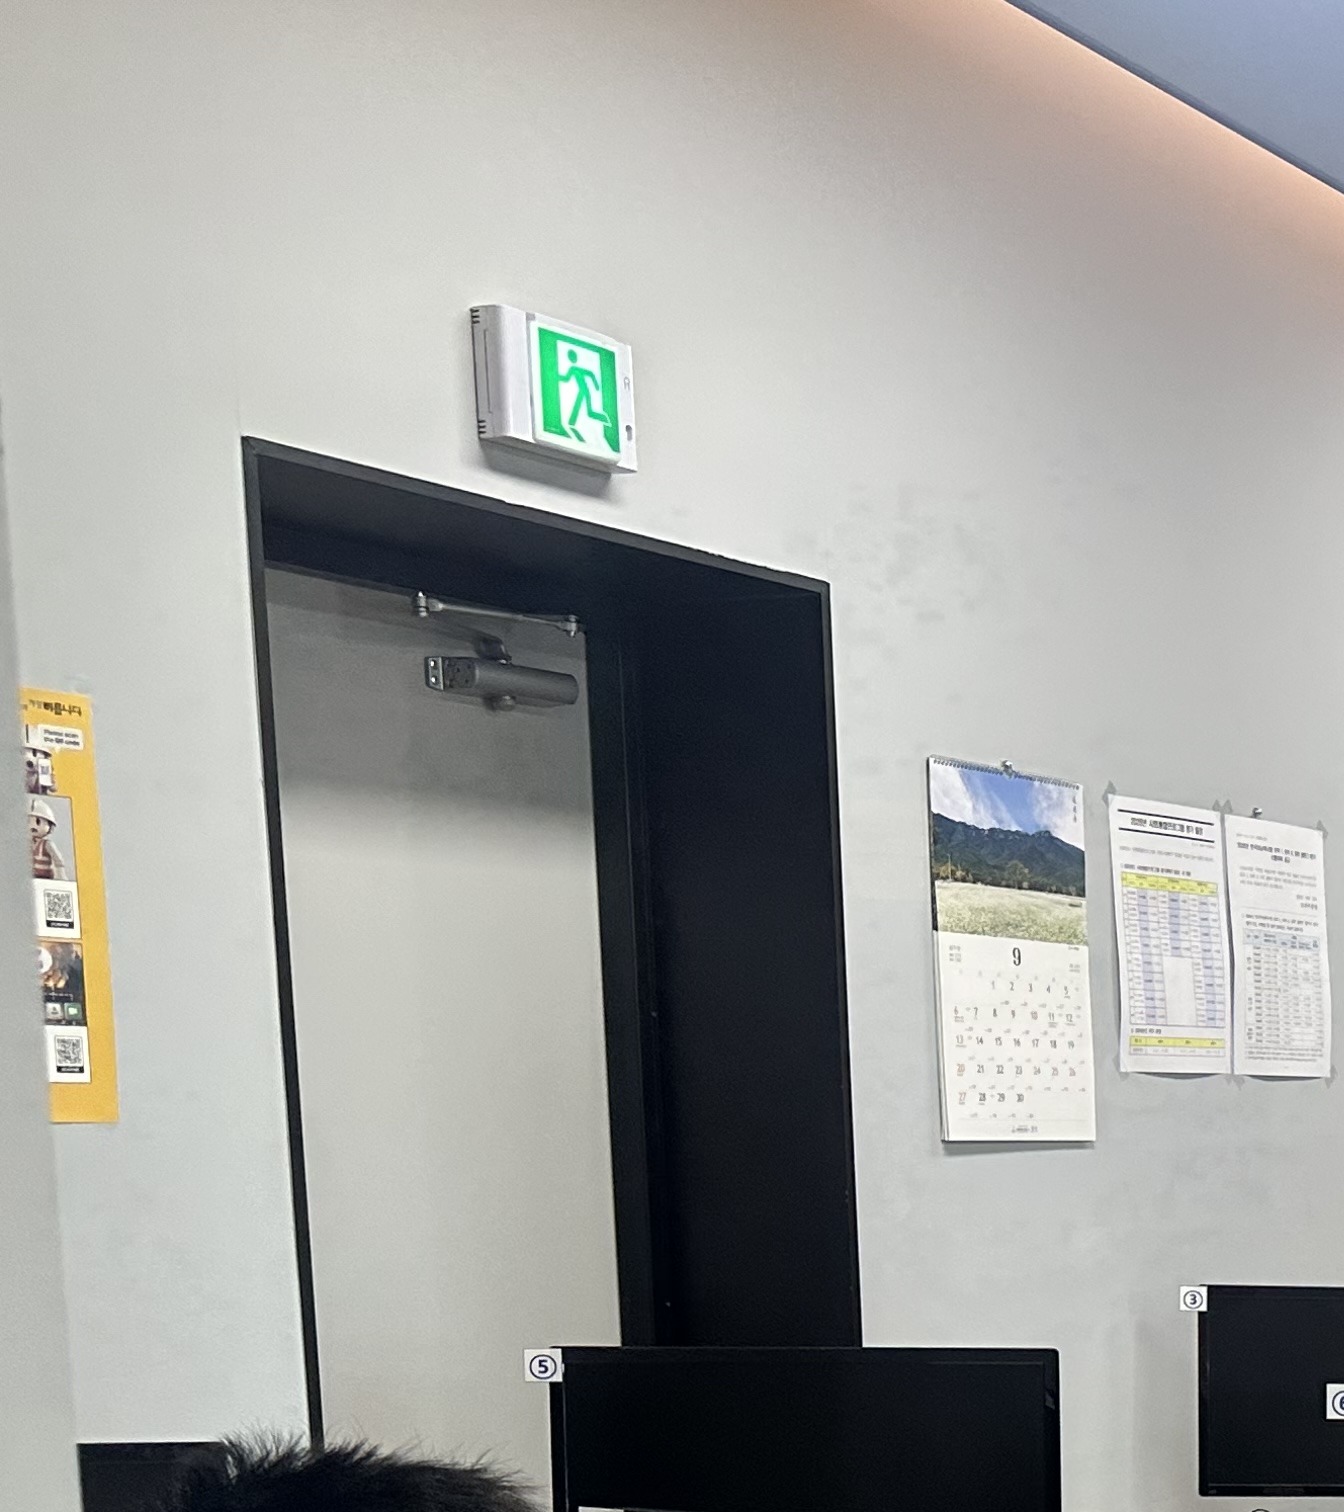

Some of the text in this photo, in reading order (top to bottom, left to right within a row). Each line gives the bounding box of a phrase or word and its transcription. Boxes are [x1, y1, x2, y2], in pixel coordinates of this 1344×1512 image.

[1012, 947, 1022, 967] 9
[1010, 981, 1015, 991] 2
[1028, 983, 1034, 993] 3
[1046, 985, 1051, 994] 4
[1064, 986, 1069, 995] 5
[954, 1006, 1073, 1023] 6 7 8 9 10 11 12
[956, 1035, 1075, 1050] 13 14 15 16 17 18 19
[957, 1063, 965, 1073] 20
[976, 1064, 985, 1074] 21
[996, 1065, 1004, 1075] 22
[1015, 1065, 1023, 1075] 23
[1033, 1066, 1041, 1075] 24
[997, 1093, 1005, 1102] 29
